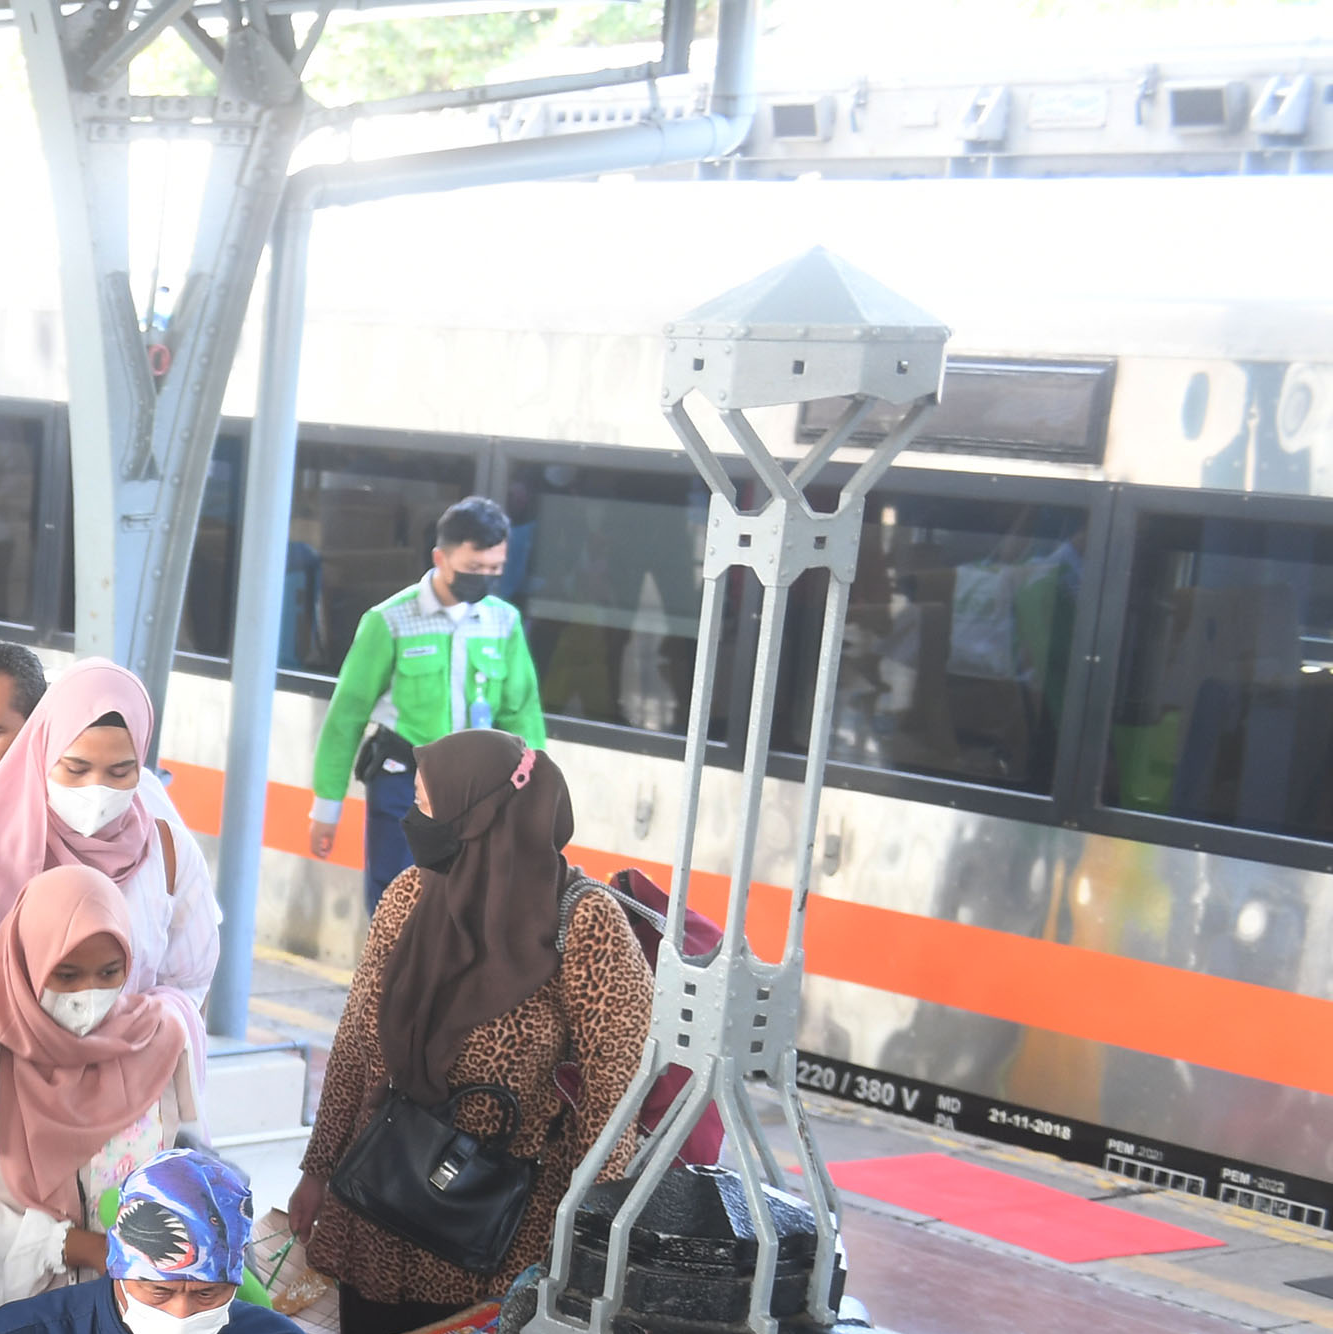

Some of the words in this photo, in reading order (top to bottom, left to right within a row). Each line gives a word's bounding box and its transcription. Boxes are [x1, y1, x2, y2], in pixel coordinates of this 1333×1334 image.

[796, 1060, 836, 1090] 220
[853, 1075, 896, 1106] 380
[901, 1086, 921, 1111] V
[936, 1094, 962, 1114] MD
[1107, 1138, 1135, 1156] PEM
[1221, 1166, 1251, 1185] PEM
